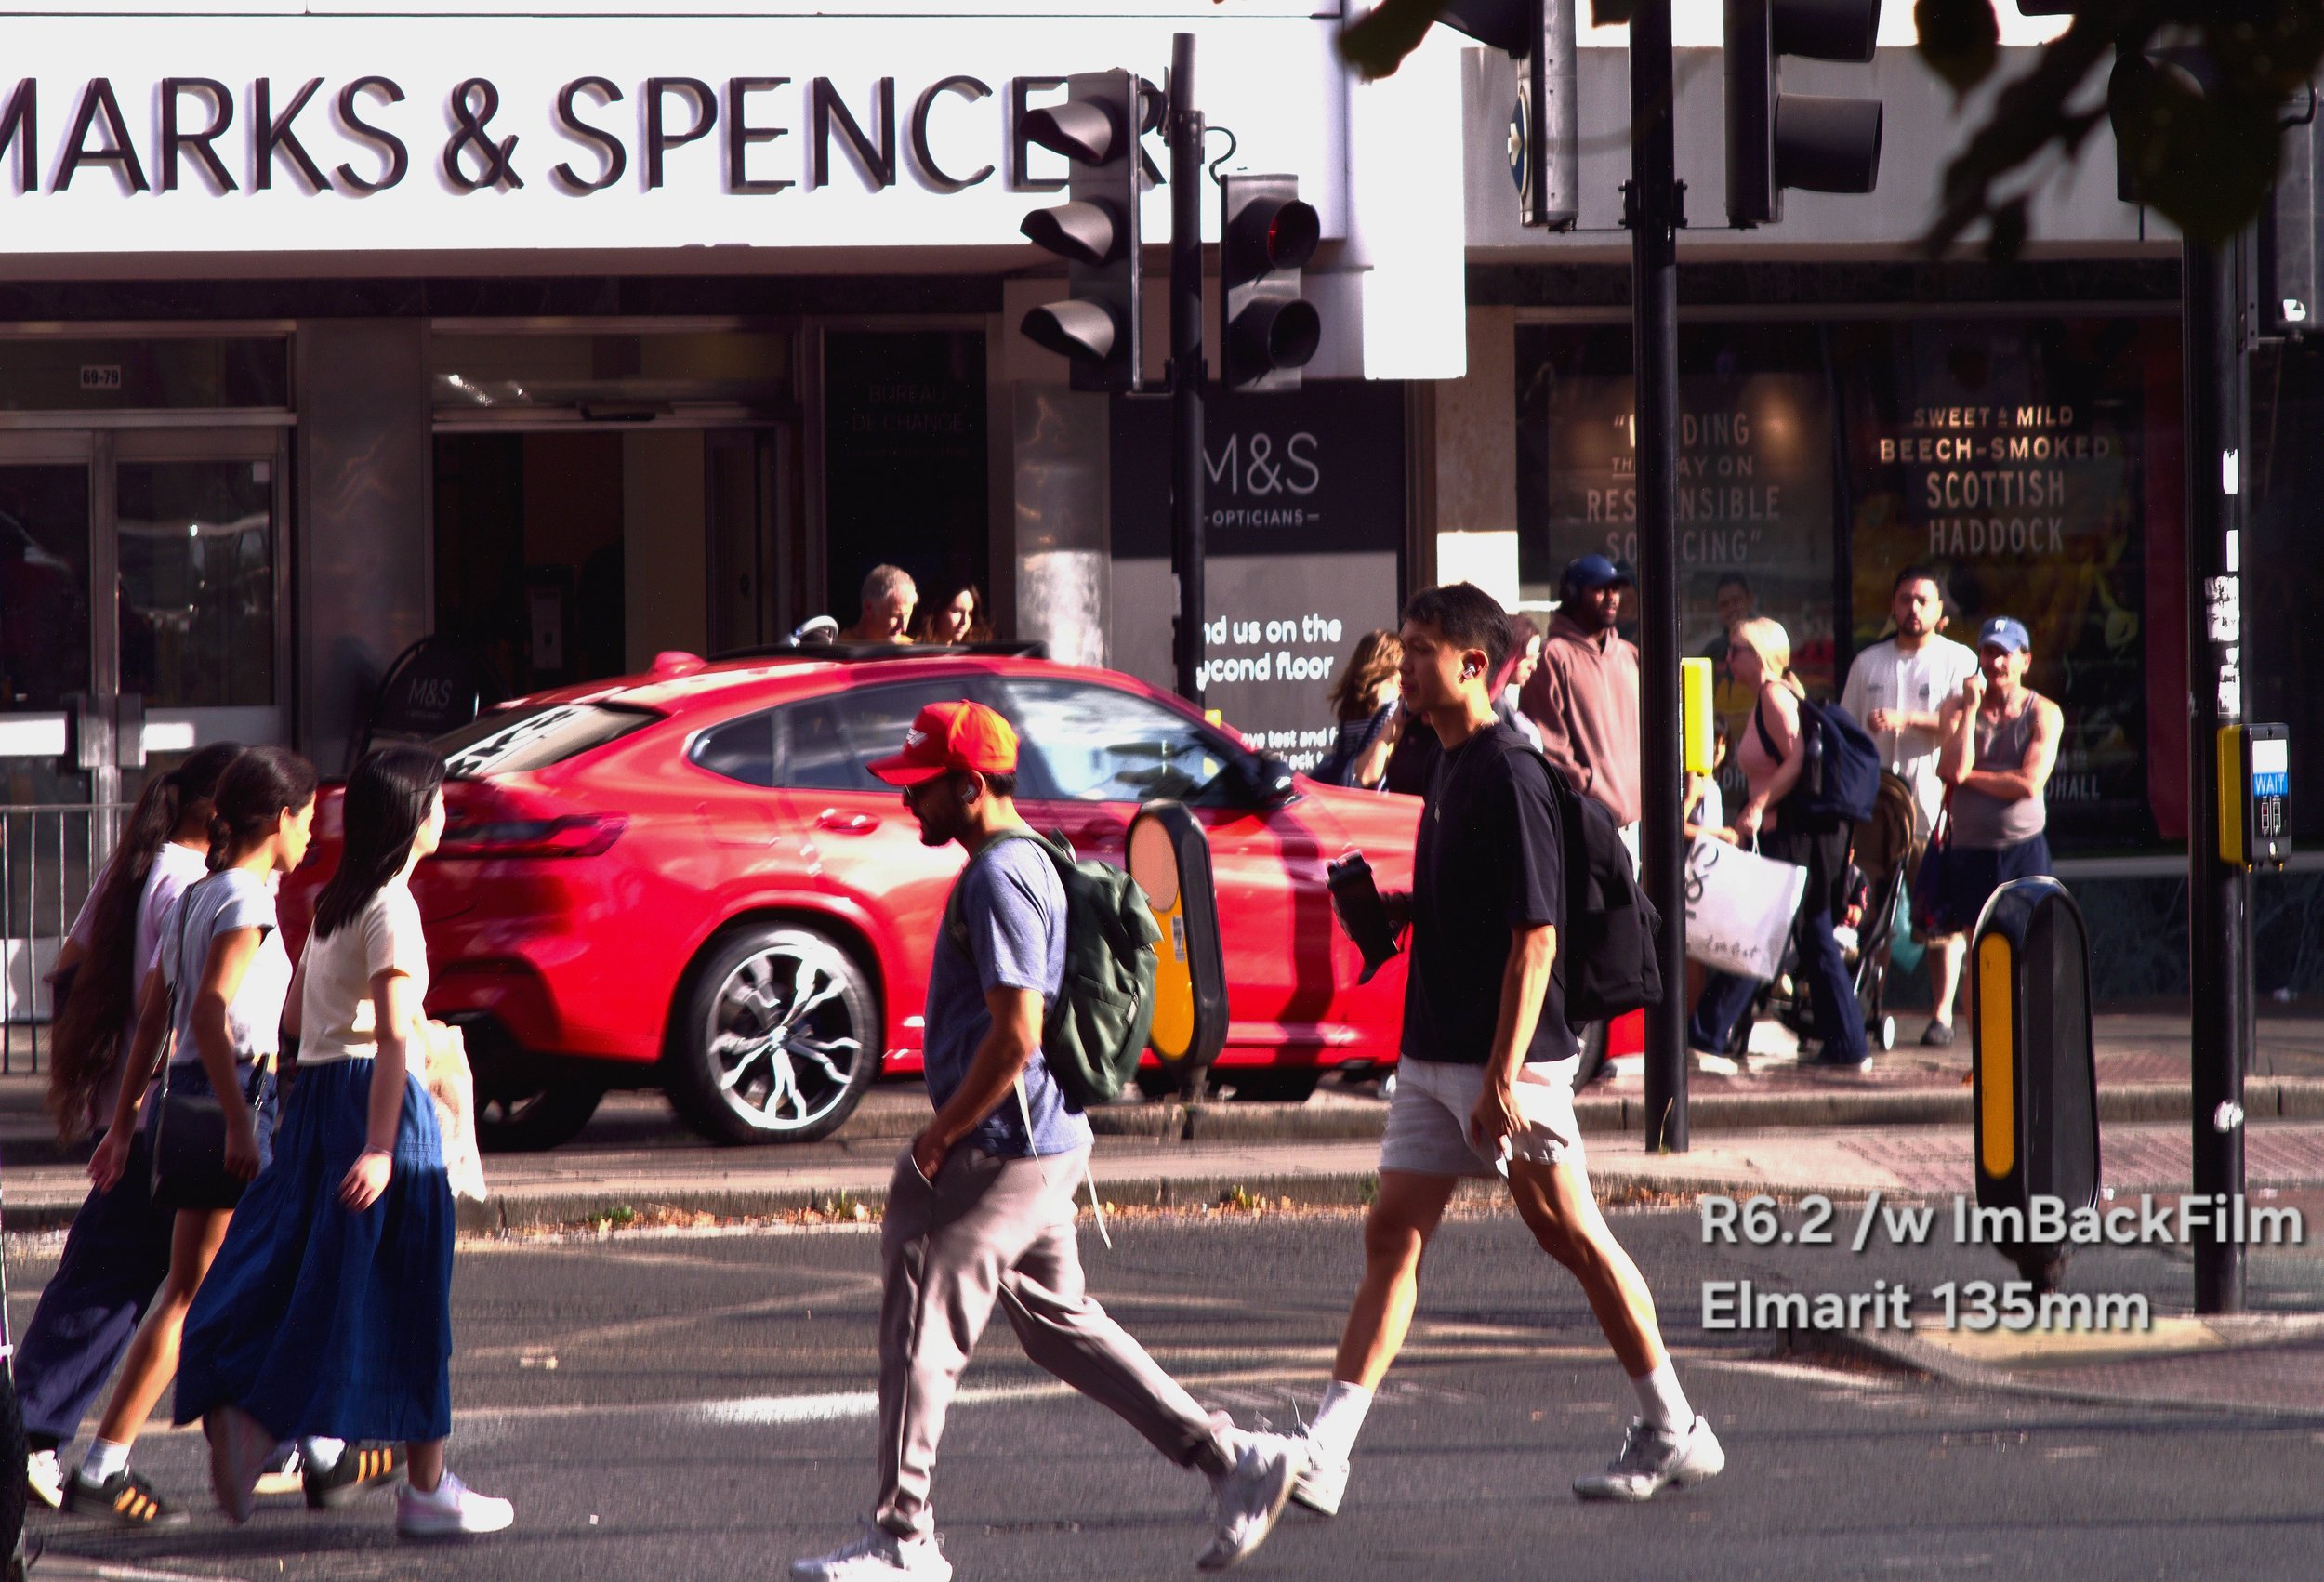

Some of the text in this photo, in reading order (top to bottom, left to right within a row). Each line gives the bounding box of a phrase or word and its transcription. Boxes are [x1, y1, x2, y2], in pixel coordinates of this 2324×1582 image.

[444, 76, 524, 191] &
[83, 369, 119, 384] 69-79
[869, 385, 946, 402] BUREAU
[852, 414, 964, 431] DE CHANGE
[1913, 406, 1990, 429] SWEET
[2016, 405, 2074, 428] MILD
[1203, 431, 1320, 495] M&S
[1880, 436, 2110, 463] BEECH-SMOKED
[1678, 455, 1709, 478] AY
[1717, 455, 1754, 478] ON
[1926, 469, 2065, 508] SCOTTISH
[1212, 508, 1303, 528] OPTICIANS
[1587, 485, 1779, 524] RESNSIBLE
[1929, 516, 2064, 556] HADDOCK
[1234, 620, 1261, 644] us
[1265, 619, 1297, 644] on
[1302, 613, 1342, 643] the
[1276, 651, 1334, 680] floor
[408, 677, 453, 709] M&S
[1268, 729, 1297, 748] test
[1300, 726, 1327, 747] and
[2255, 773, 2285, 797] WAIT
